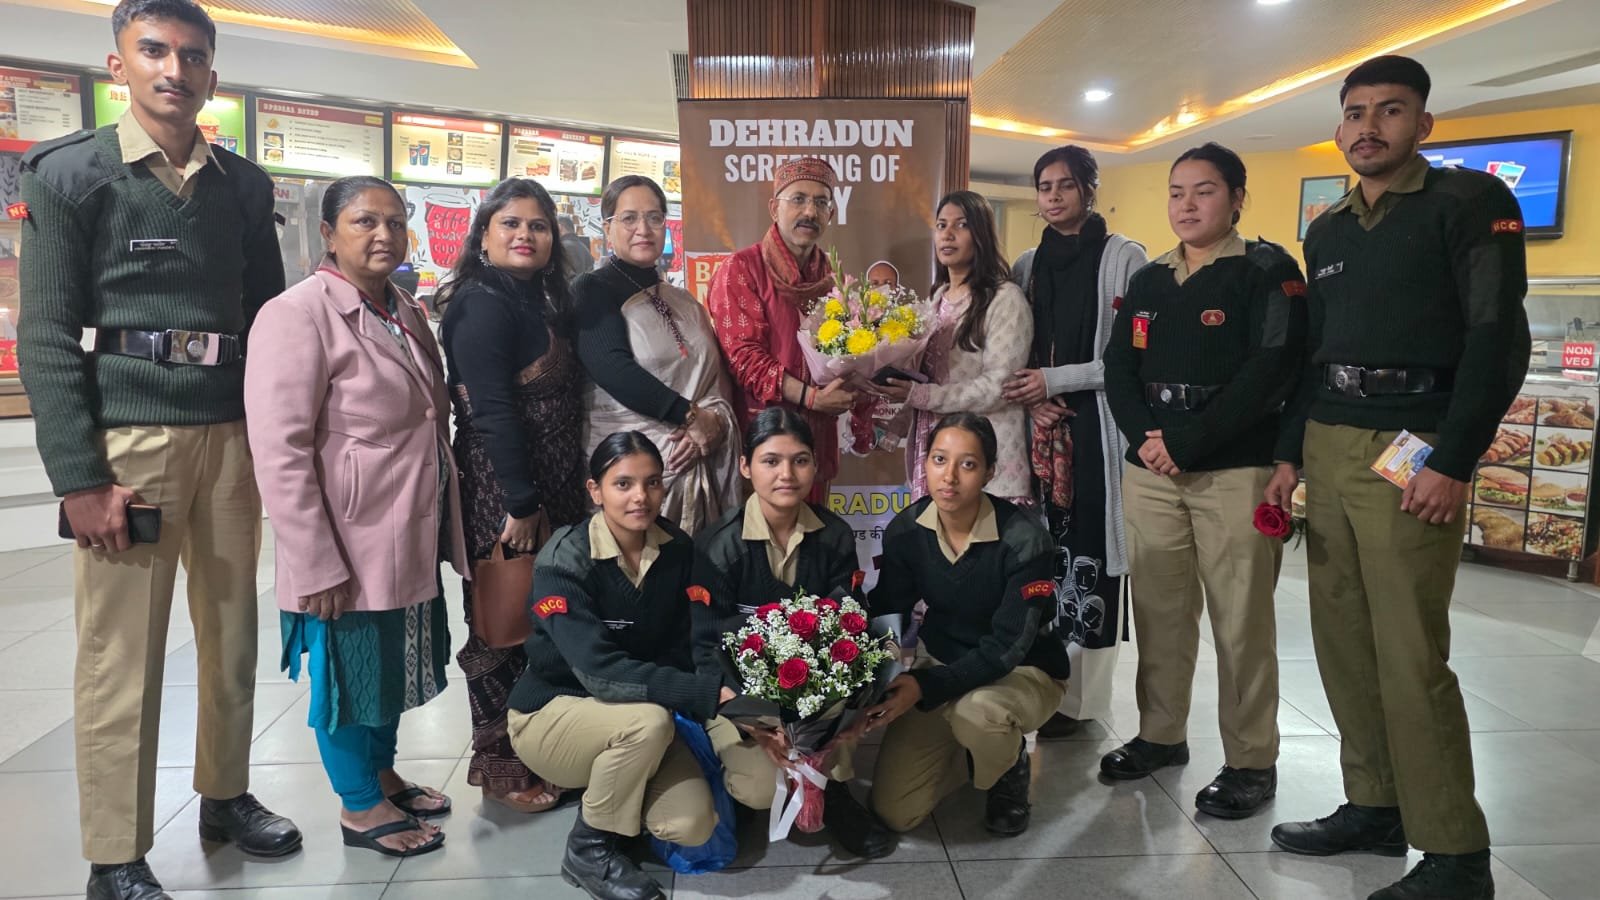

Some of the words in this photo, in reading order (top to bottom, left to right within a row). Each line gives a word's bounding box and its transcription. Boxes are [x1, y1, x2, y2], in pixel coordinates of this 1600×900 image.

[709, 119, 914, 148] DEHRADUN
[724, 153, 862, 183] SCRNG
[870, 154, 900, 182] OF
[1566, 346, 1593, 356] NON
[1565, 356, 1591, 367] VEG
[828, 492, 912, 516] RADU
[1027, 583, 1049, 595] NCC
[539, 599, 564, 614] NCC
